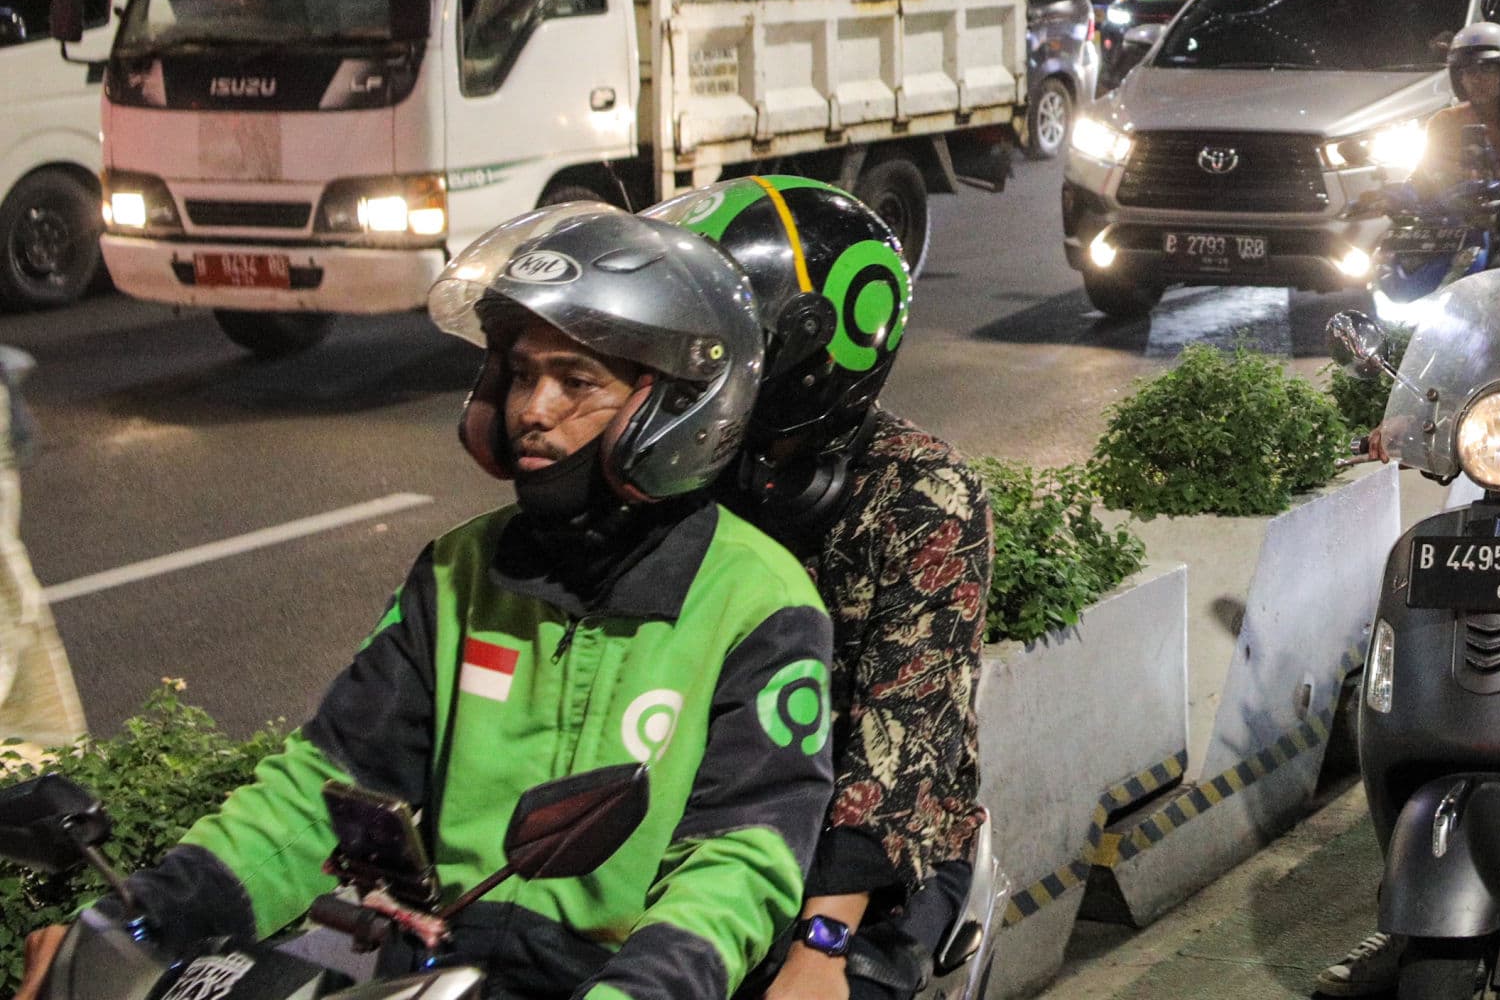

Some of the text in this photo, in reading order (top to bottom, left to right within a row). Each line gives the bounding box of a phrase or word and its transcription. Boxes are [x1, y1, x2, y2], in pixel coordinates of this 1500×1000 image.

[210, 77, 277, 97] ISUZU
[1166, 234, 1177, 254] B
[1187, 235, 1226, 255] 2793
[1420, 543, 1435, 569] B
